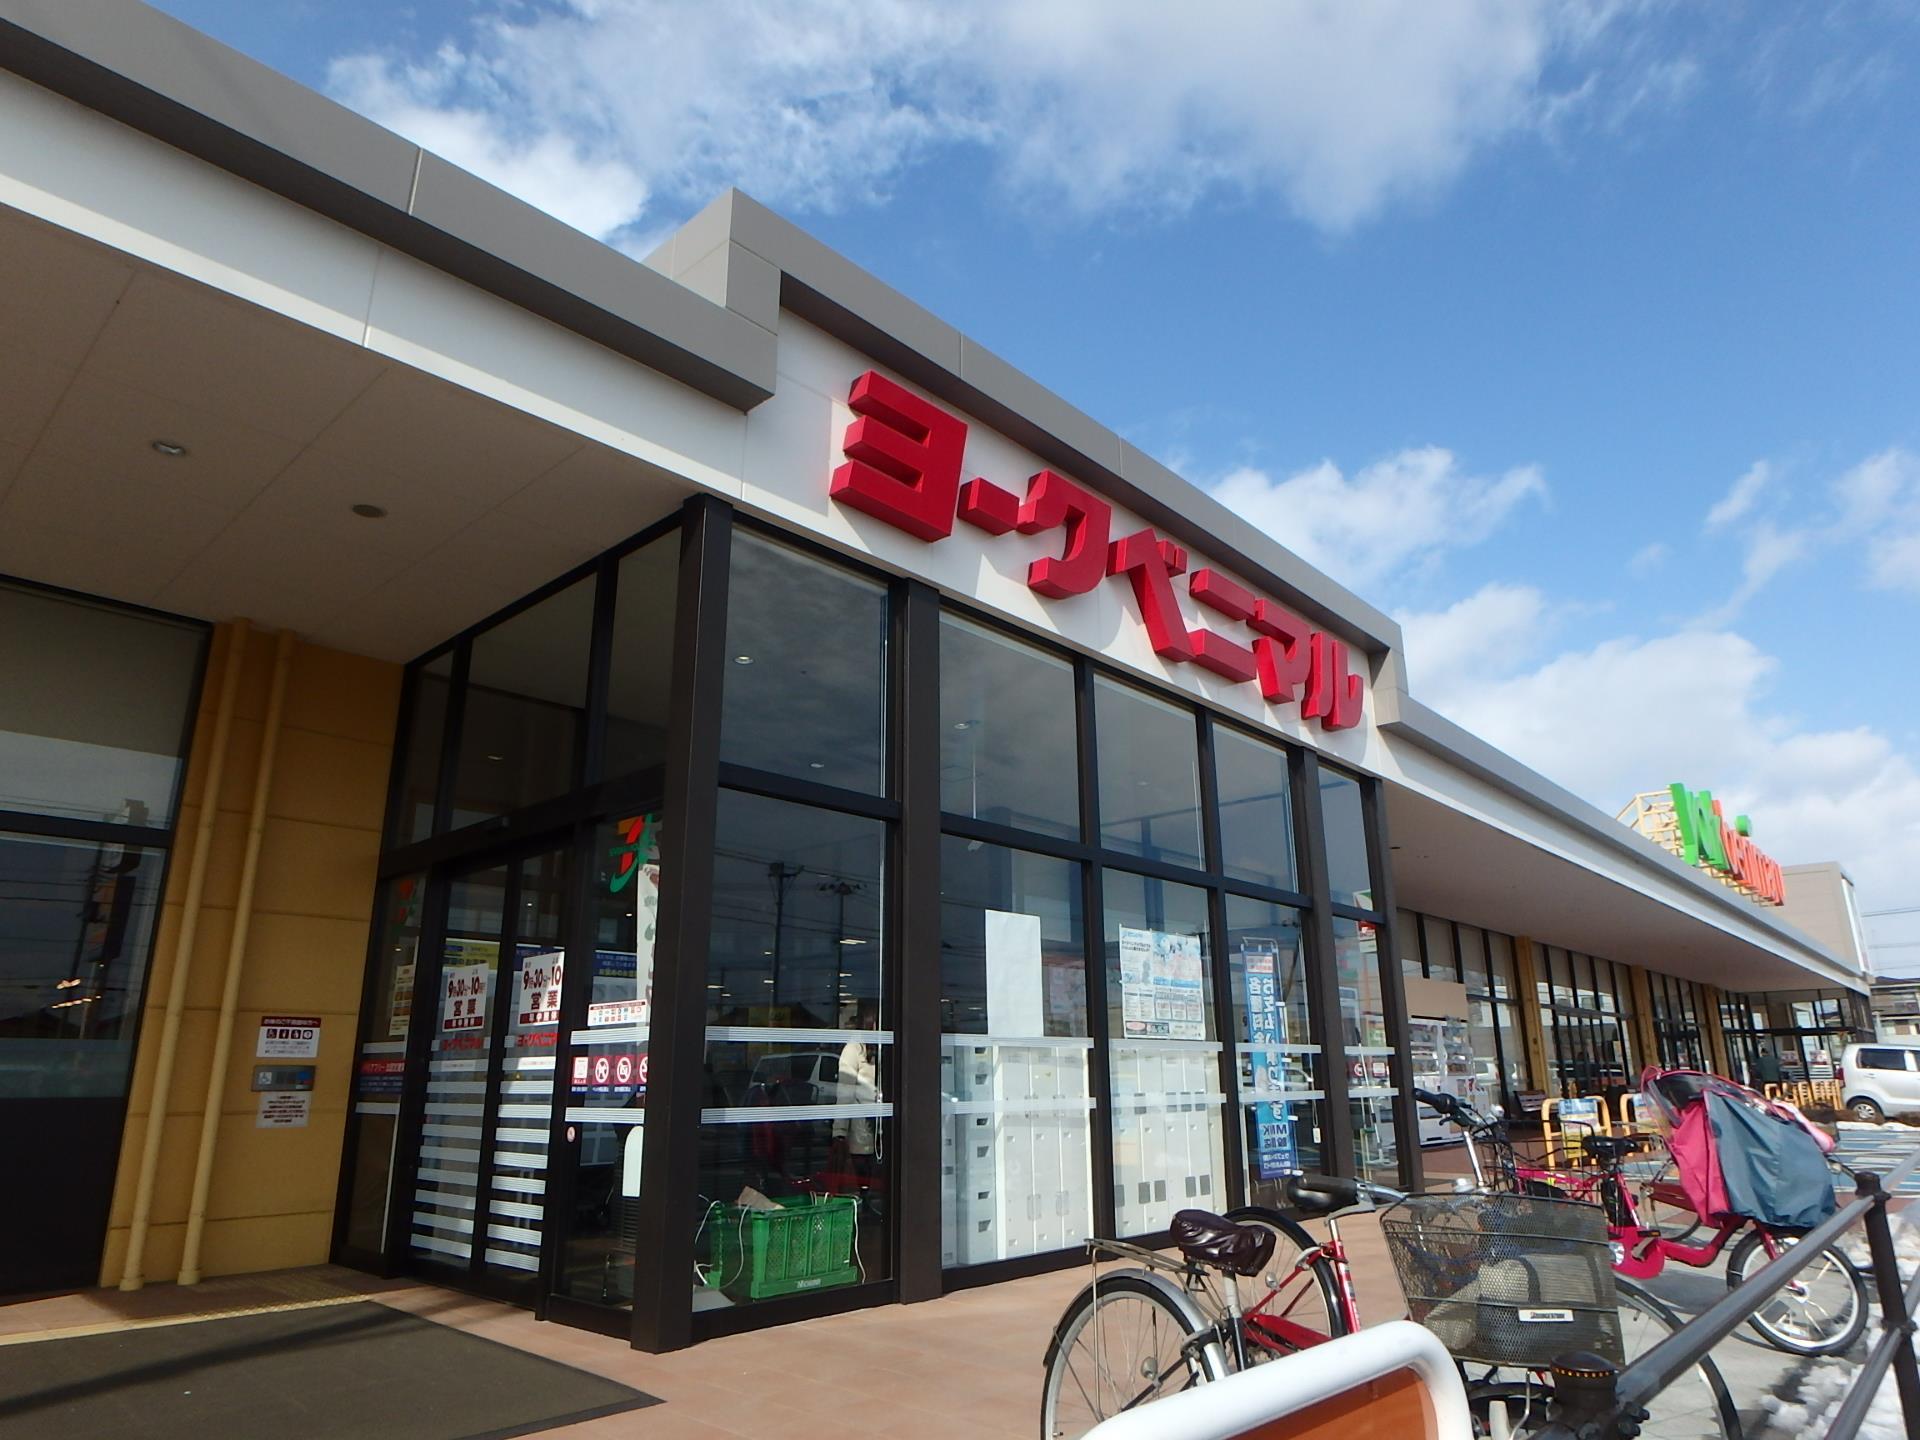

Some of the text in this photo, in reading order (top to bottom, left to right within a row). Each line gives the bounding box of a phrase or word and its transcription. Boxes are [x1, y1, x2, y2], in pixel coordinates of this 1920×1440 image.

[830, 369, 1364, 732] ヨークベニマル
[453, 998, 477, 1017] 営業
[531, 990, 558, 1010] 営業
